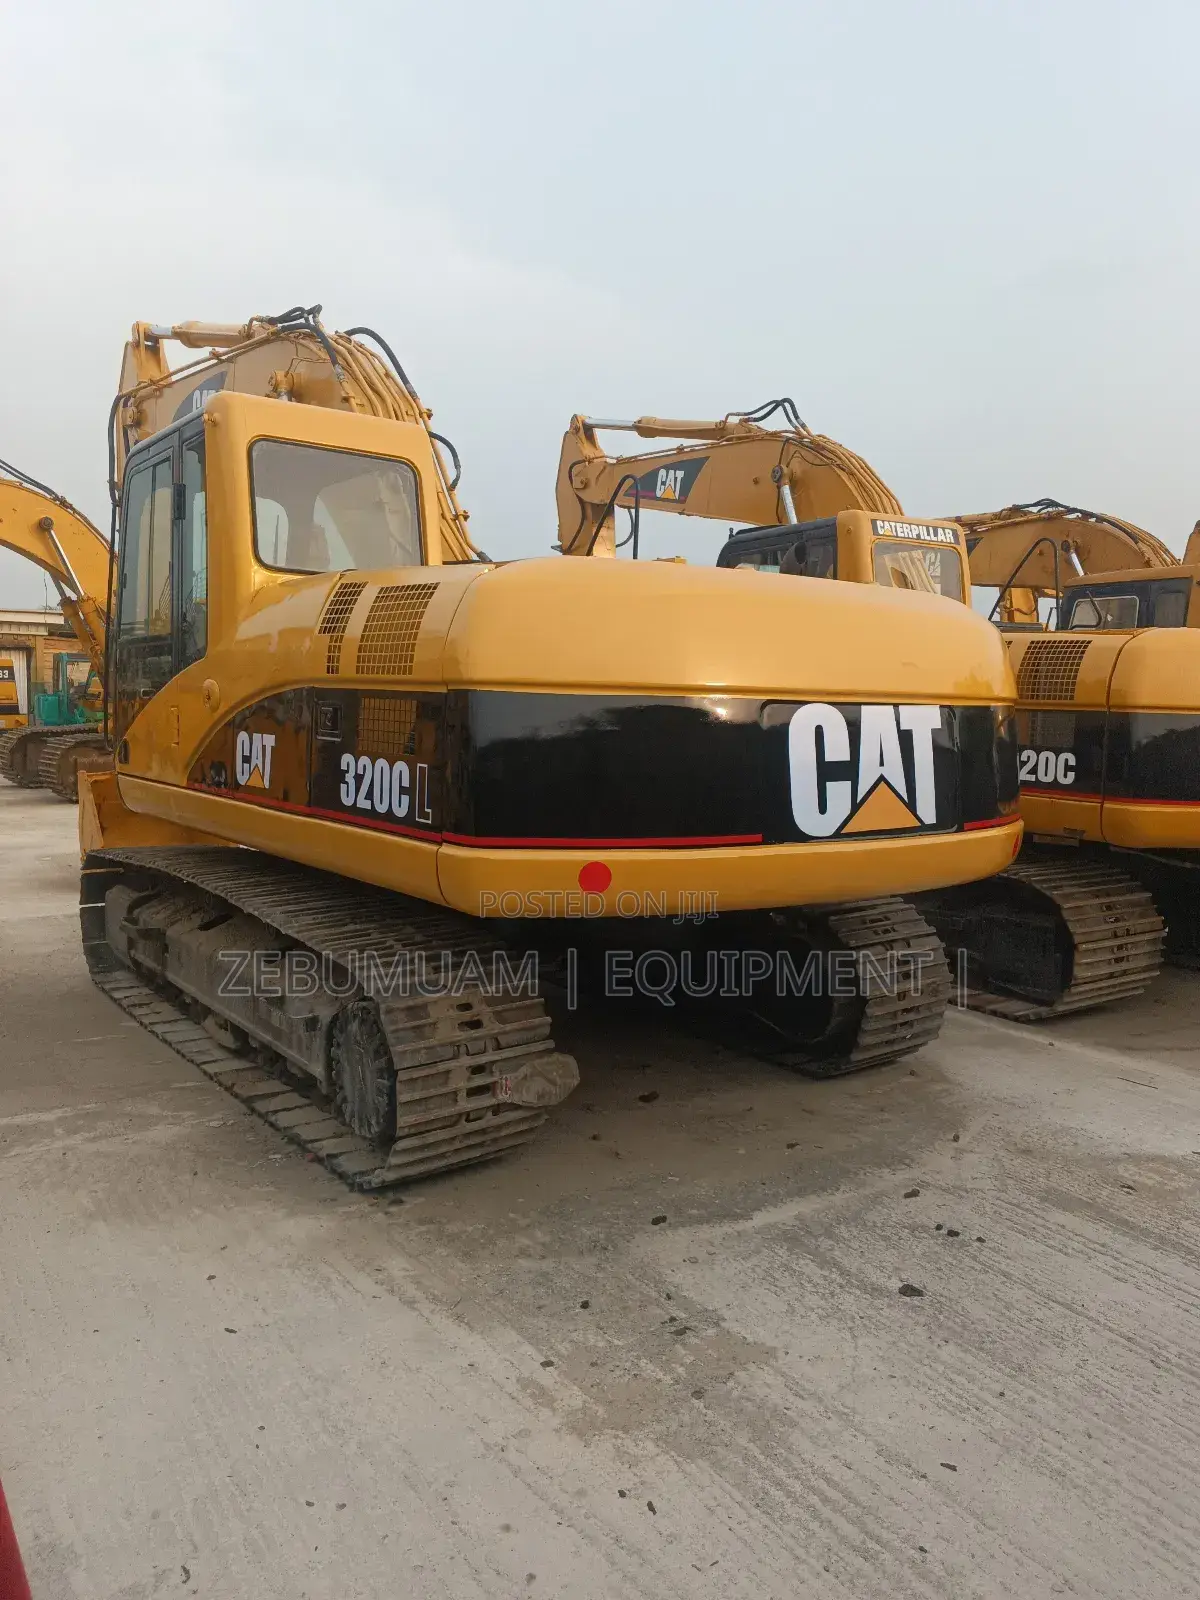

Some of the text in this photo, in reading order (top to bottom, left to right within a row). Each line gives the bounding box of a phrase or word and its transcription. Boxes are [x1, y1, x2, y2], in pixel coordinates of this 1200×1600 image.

[656, 469, 685, 500] CAT
[876, 520, 955, 543] CATERPILLAR
[236, 731, 276, 789] CAT
[788, 702, 942, 836] CAT
[1017, 749, 1076, 785] 20C
[340, 753, 432, 824] 320C L
